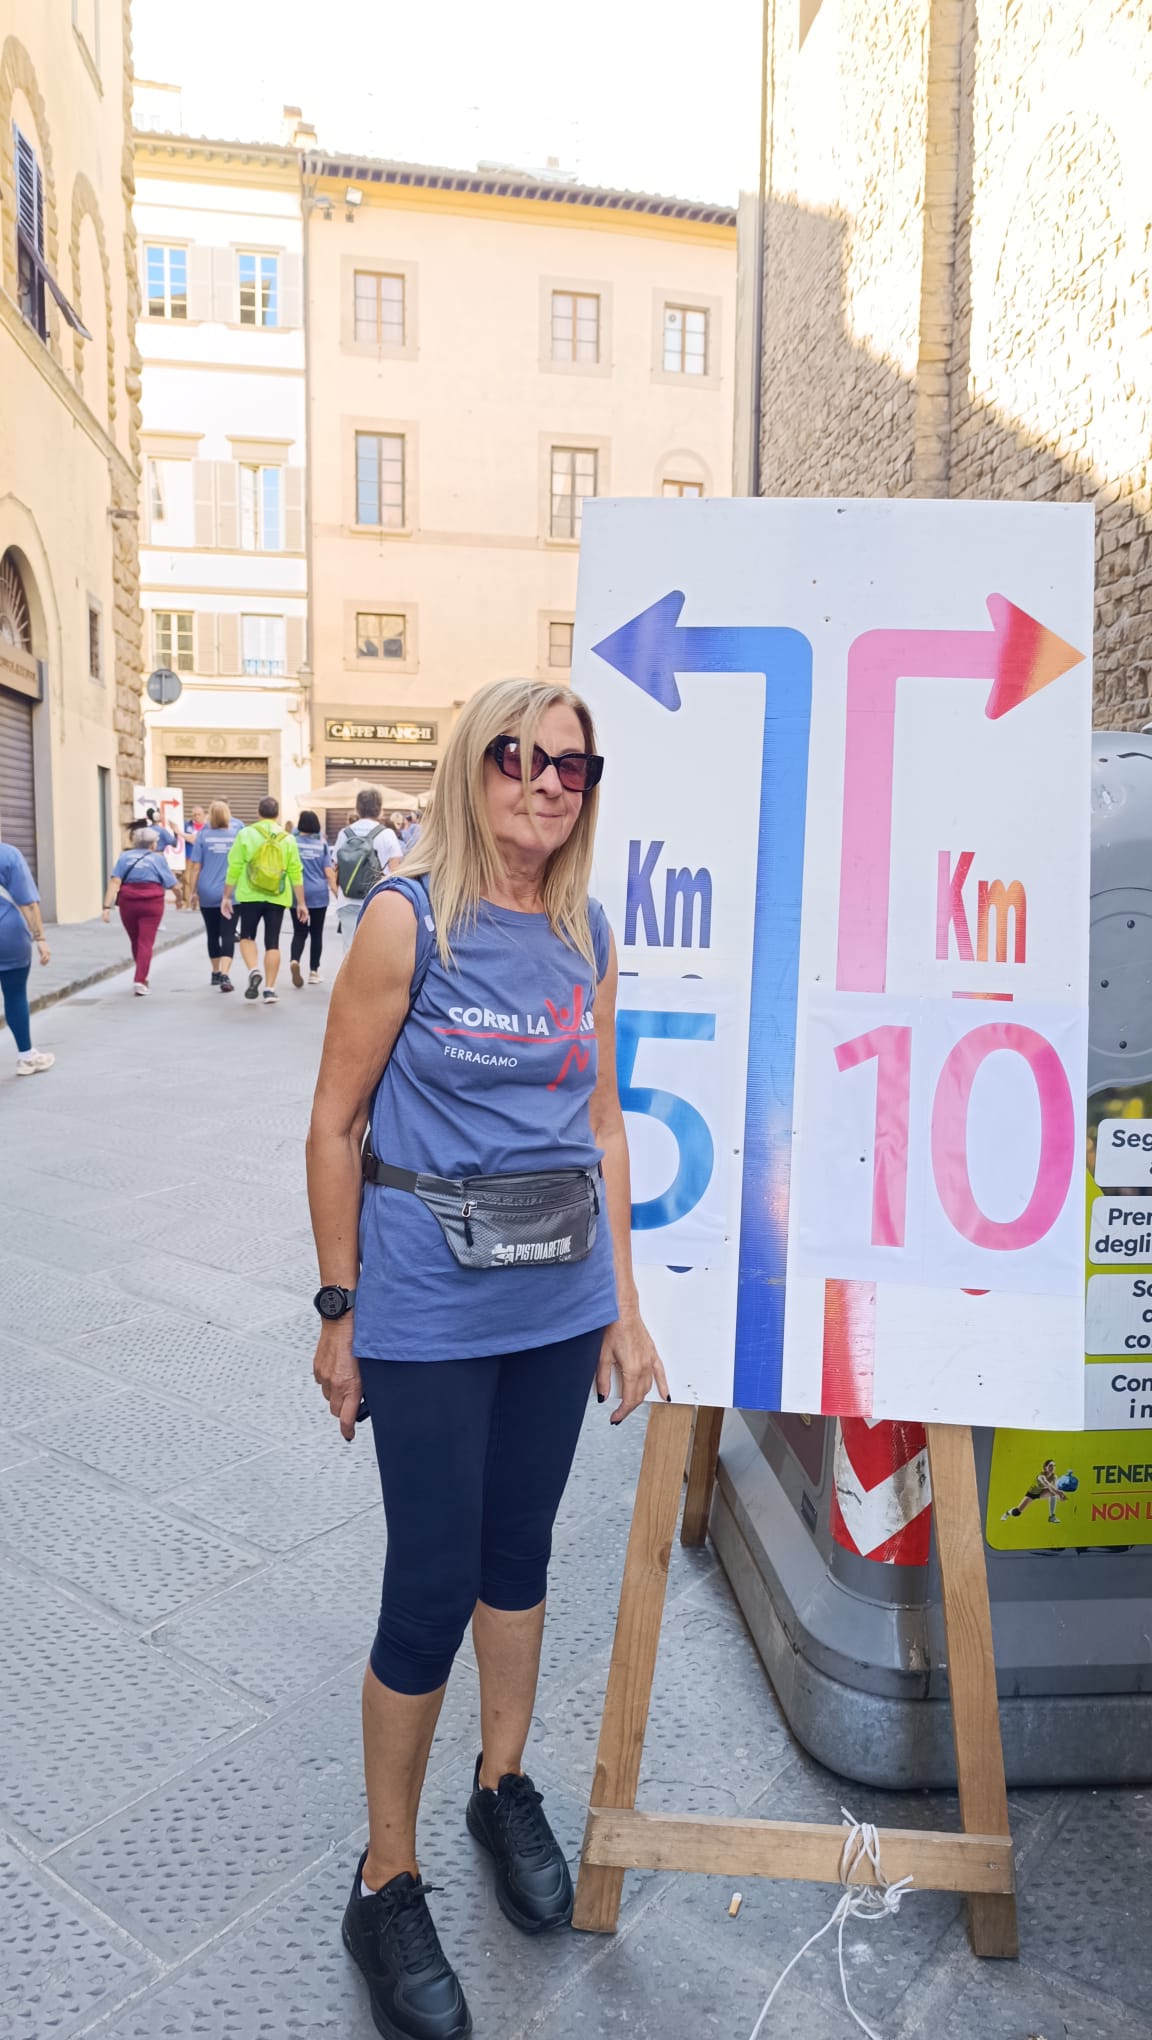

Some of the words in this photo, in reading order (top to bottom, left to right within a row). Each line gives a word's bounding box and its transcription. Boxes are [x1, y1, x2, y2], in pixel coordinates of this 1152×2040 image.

[376, 726, 432, 740] BIANCHI
[354, 759, 410, 767] TABACCHI
[624, 839, 713, 949] Km
[935, 850, 1027, 964] Km
[448, 1006, 519, 1033] CORRI
[526, 1014, 550, 1036] LA
[443, 1045, 518, 1068] FERRAGAMO
[615, 1009, 717, 1231] 5
[833, 1022, 1075, 1251] 10
[1094, 1232, 1152, 1257] degli
[1129, 1398, 1136, 1419] i
[1091, 1502, 1140, 1521] NON
